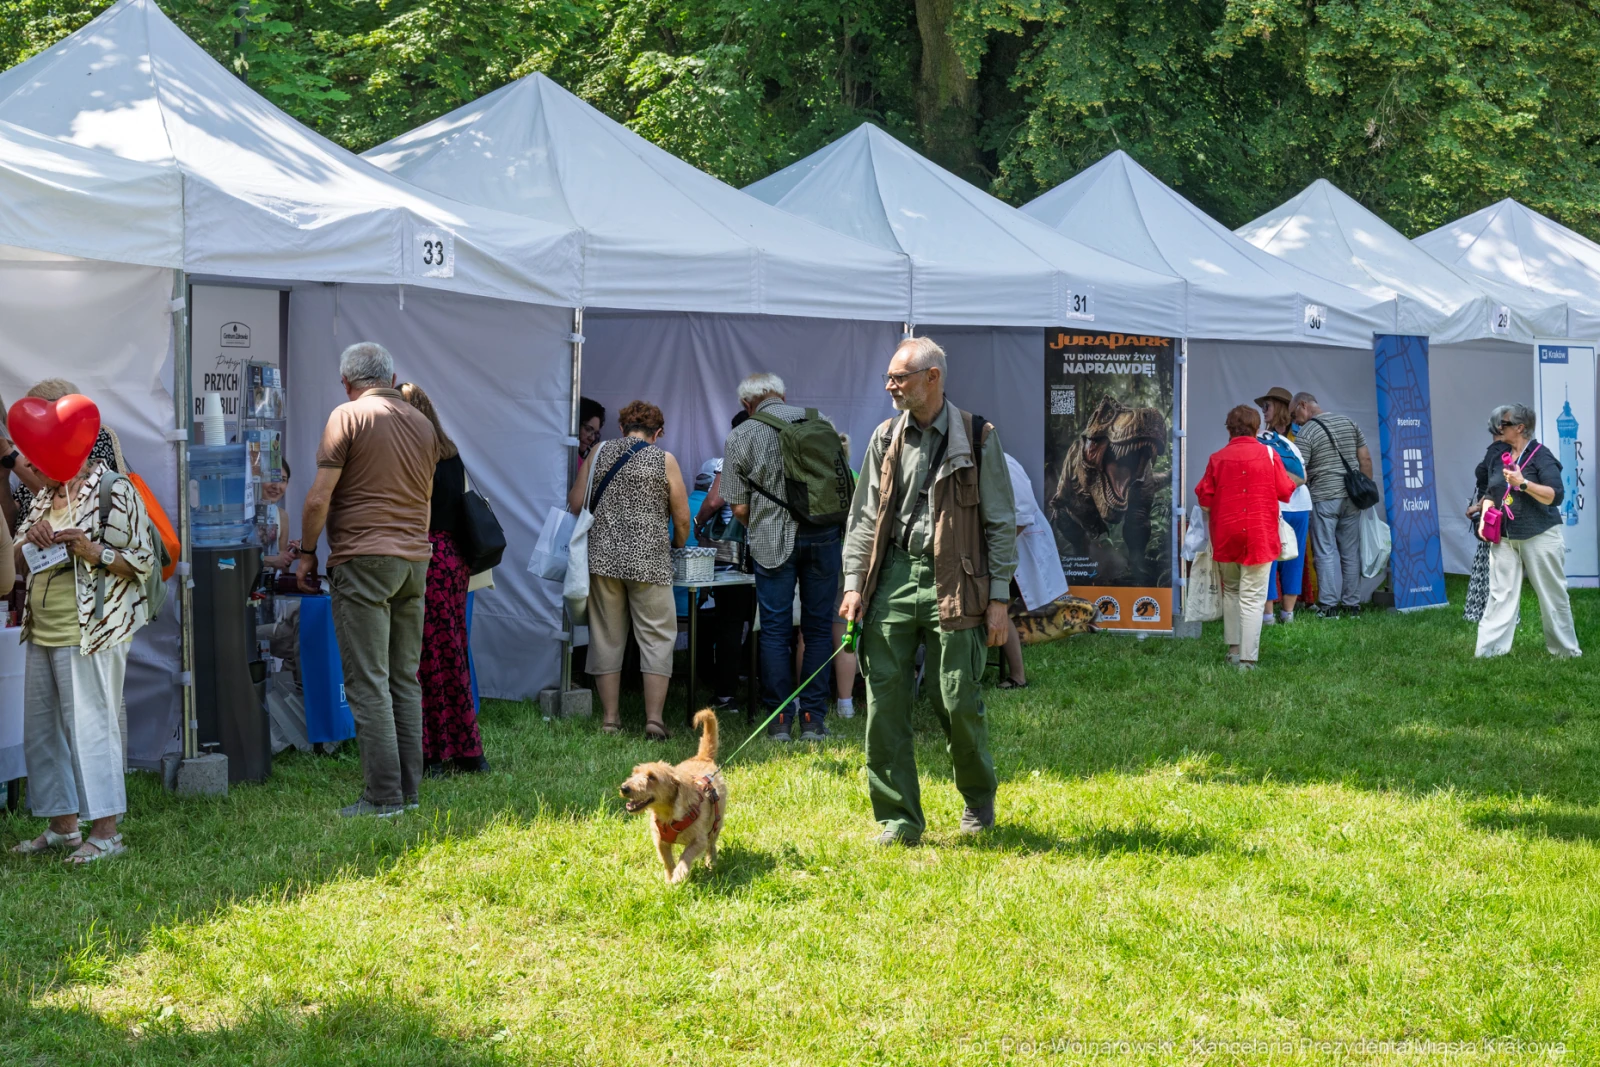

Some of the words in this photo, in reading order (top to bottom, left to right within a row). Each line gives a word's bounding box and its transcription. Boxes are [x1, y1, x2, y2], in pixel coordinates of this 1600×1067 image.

[423, 240, 444, 266] 33
[1073, 294, 1087, 313] 31
[1309, 314, 1321, 330] 30
[1497, 313, 1508, 328] 29
[1063, 353, 1076, 361] TU
[1077, 353, 1131, 361] DINOZAURY
[1133, 352, 1156, 362] ŻYŁY
[1548, 350, 1566, 359] Kraków
[1063, 362, 1156, 377] NAPRAWDĘ!
[204, 373, 239, 391] PRZYCH
[1397, 417, 1421, 427] #seniorzy
[834, 458, 848, 509] adidas
[1402, 496, 1430, 511] Kraków
